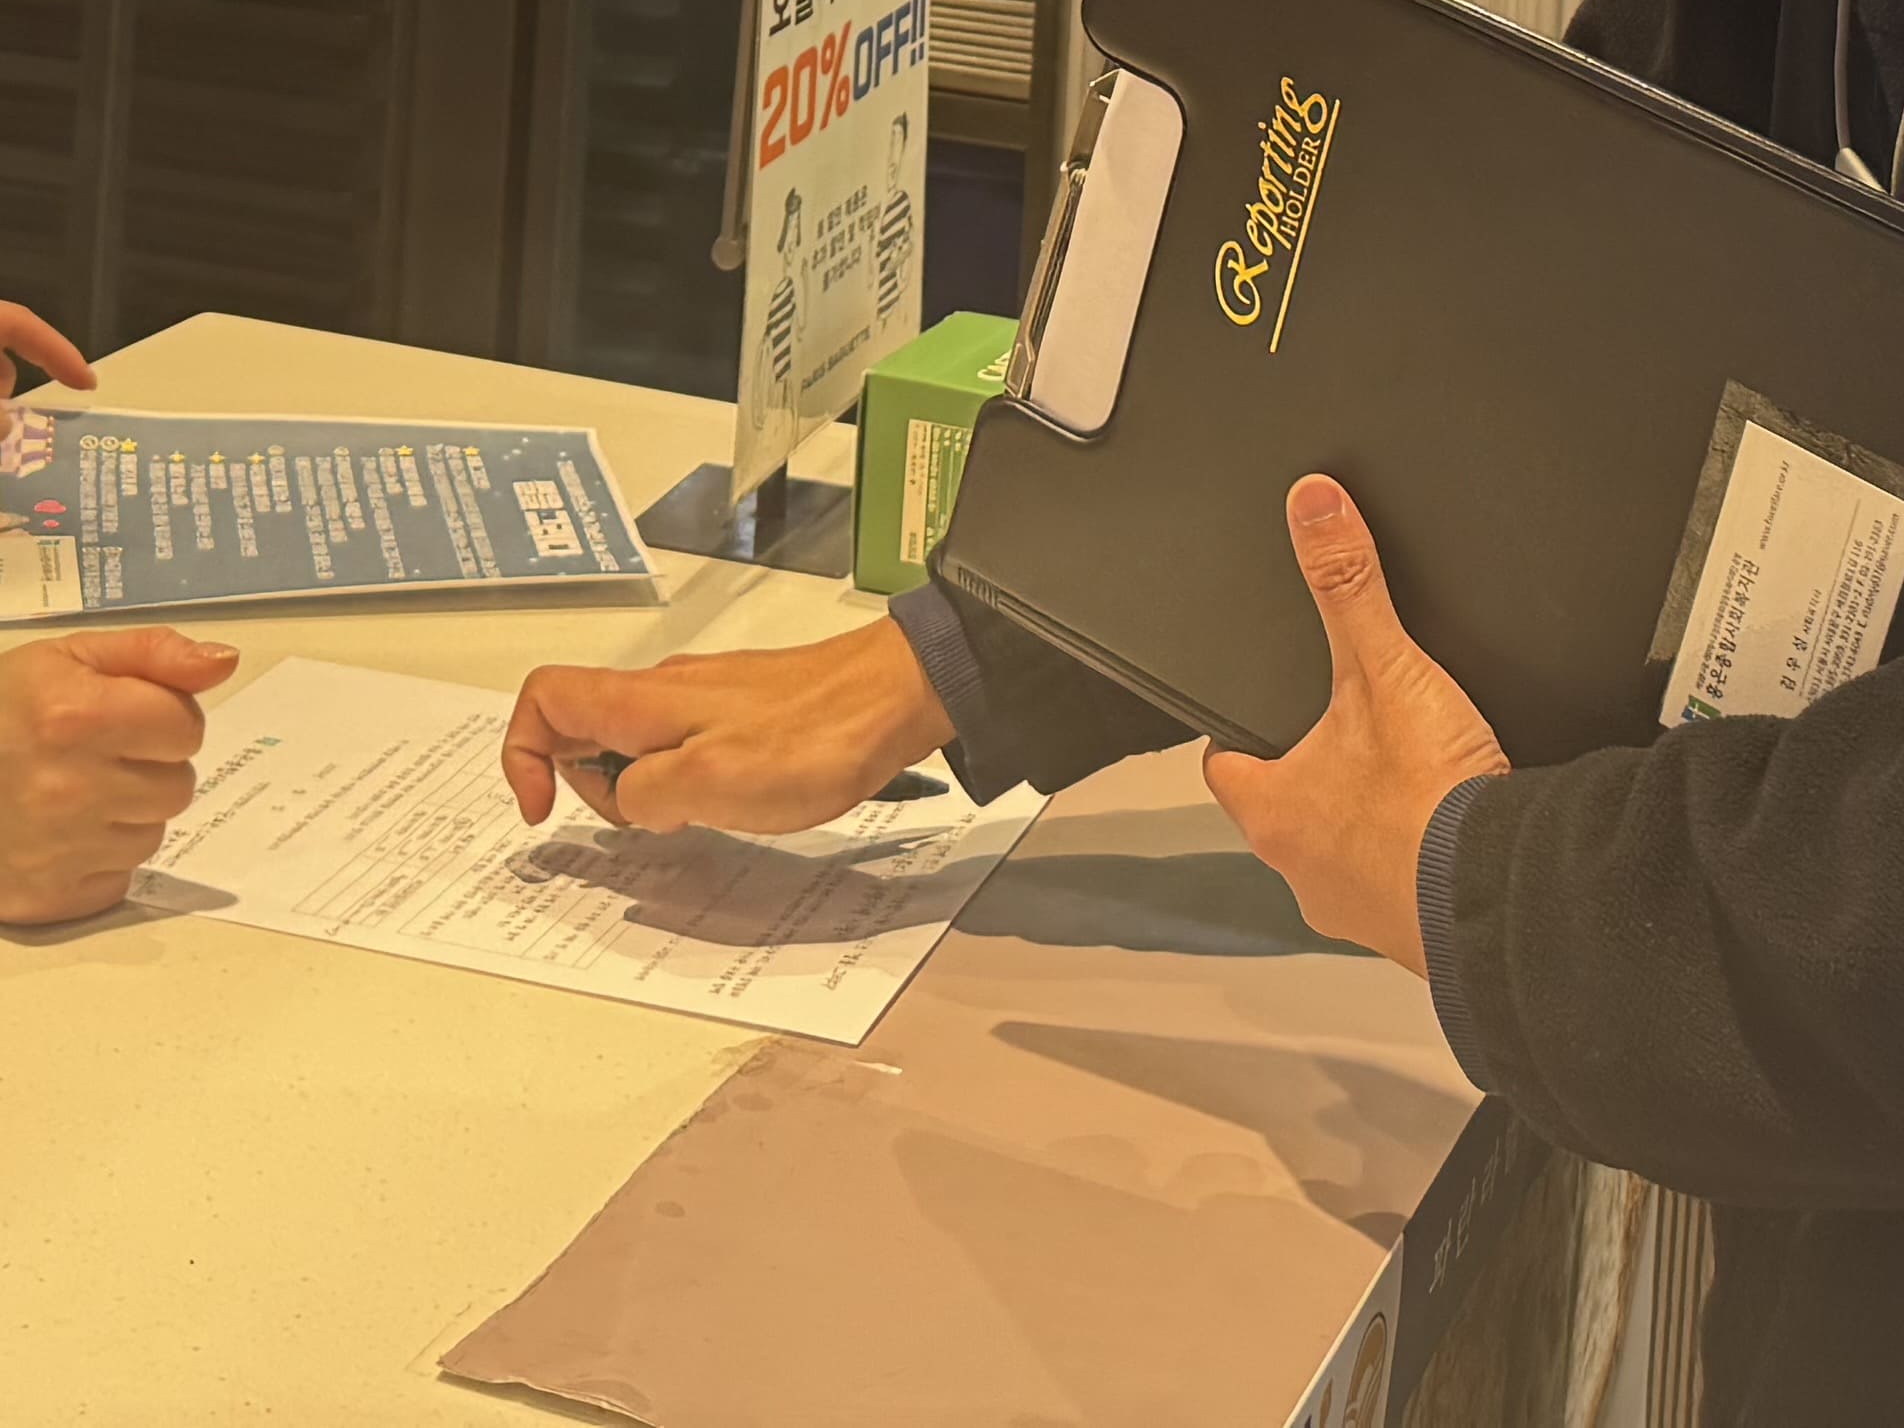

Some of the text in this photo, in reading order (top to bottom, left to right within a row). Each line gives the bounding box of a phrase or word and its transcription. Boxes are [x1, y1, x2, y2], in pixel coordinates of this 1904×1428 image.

[1214, 75, 1330, 327] Reporting
[1280, 135, 1322, 240] HOLDER
[1706, 558, 1761, 700] 홍은종합사회복지관
